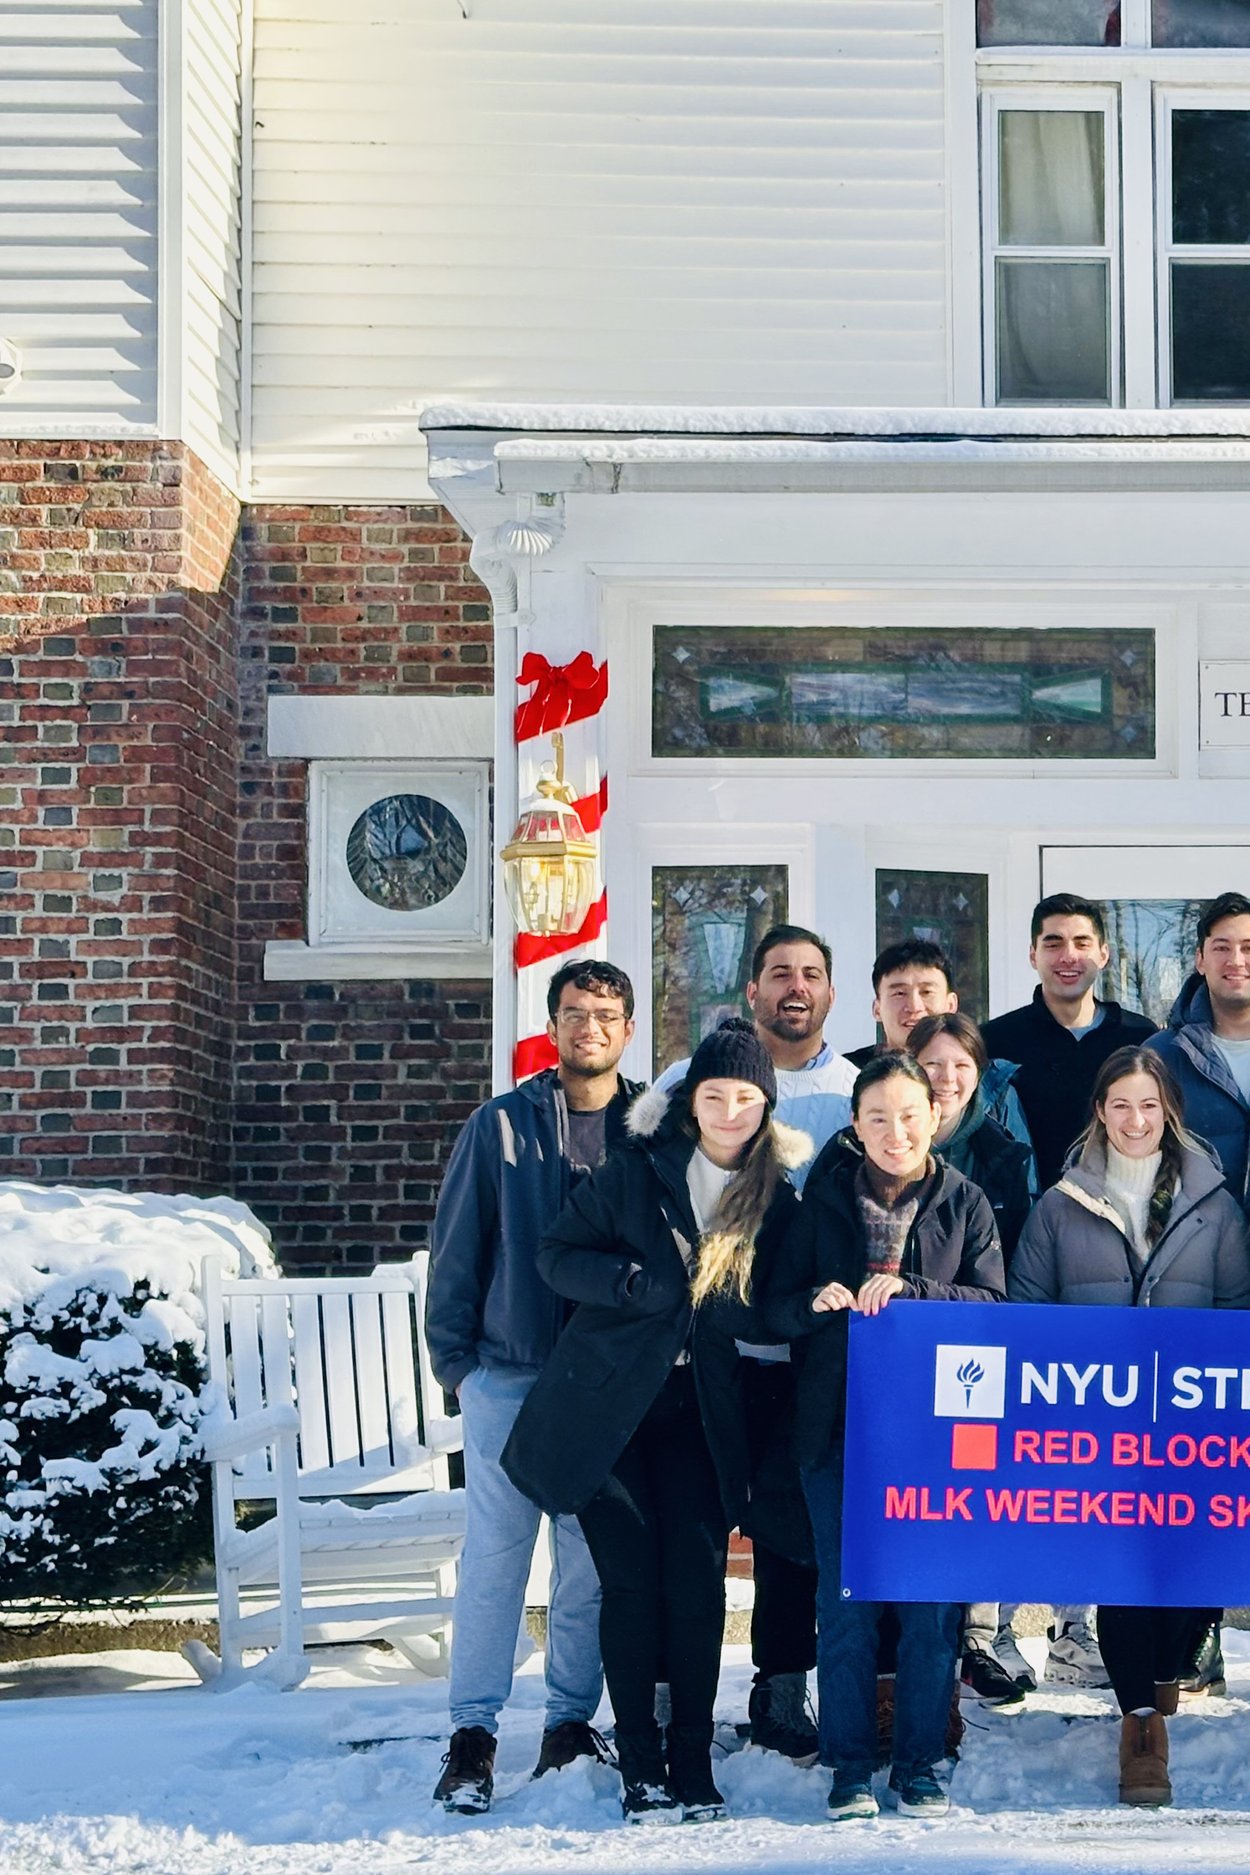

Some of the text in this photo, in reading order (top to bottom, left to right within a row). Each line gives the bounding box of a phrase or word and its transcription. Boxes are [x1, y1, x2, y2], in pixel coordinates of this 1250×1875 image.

[1020, 1362, 1139, 1407] NYU
[1013, 1429, 1100, 1465] RED
[884, 1486, 974, 1521] MLK
[985, 1489, 1196, 1526] WEEKEND
